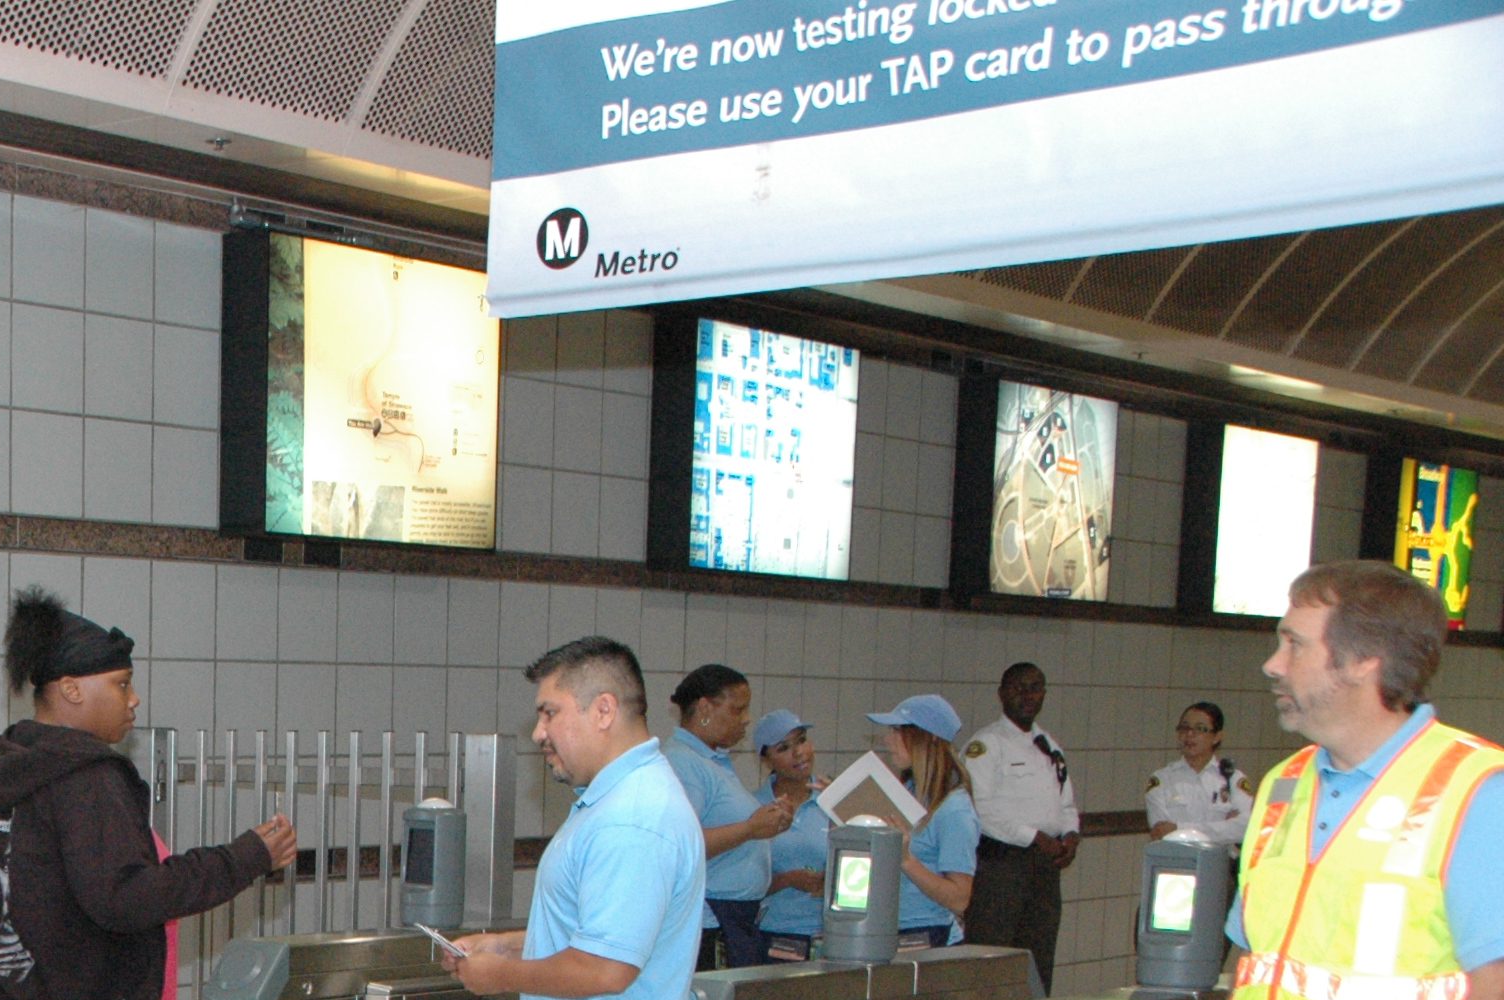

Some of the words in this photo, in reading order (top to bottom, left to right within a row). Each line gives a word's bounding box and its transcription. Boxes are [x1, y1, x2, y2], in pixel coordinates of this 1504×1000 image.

[600, 38, 698, 82] We're
[709, 28, 784, 67] now
[792, 0, 917, 45] testing
[601, 98, 708, 140] Please
[719, 88, 783, 123] use
[791, 73, 873, 124] your
[880, 49, 954, 97] TAP
[964, 26, 1054, 82] card
[1066, 28, 1109, 66] to
[1121, 9, 1227, 69] pass
[593, 248, 680, 278] Metro
